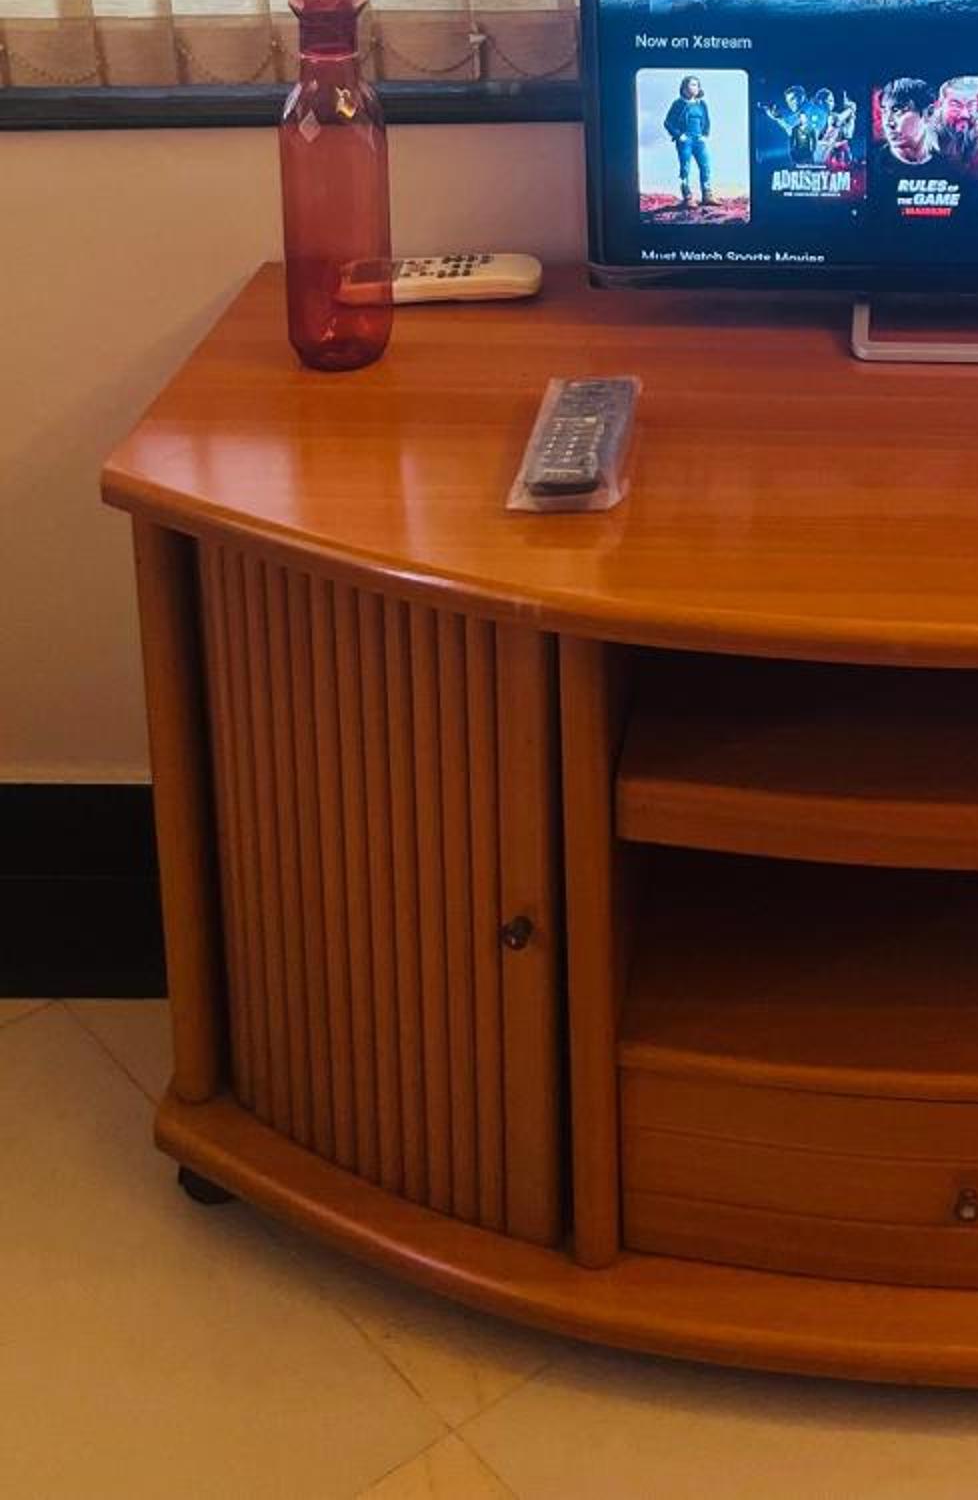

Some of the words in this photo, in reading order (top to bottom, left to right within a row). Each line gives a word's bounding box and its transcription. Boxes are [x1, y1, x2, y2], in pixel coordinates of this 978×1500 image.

[635, 33, 669, 49] Now
[671, 37, 689, 49] on
[692, 34, 753, 49] Xstream
[771, 169, 851, 192] ADRISHYAM
[897, 179, 949, 192] RULES
[913, 193, 961, 207] GAME
[679, 250, 723, 261] Watch
